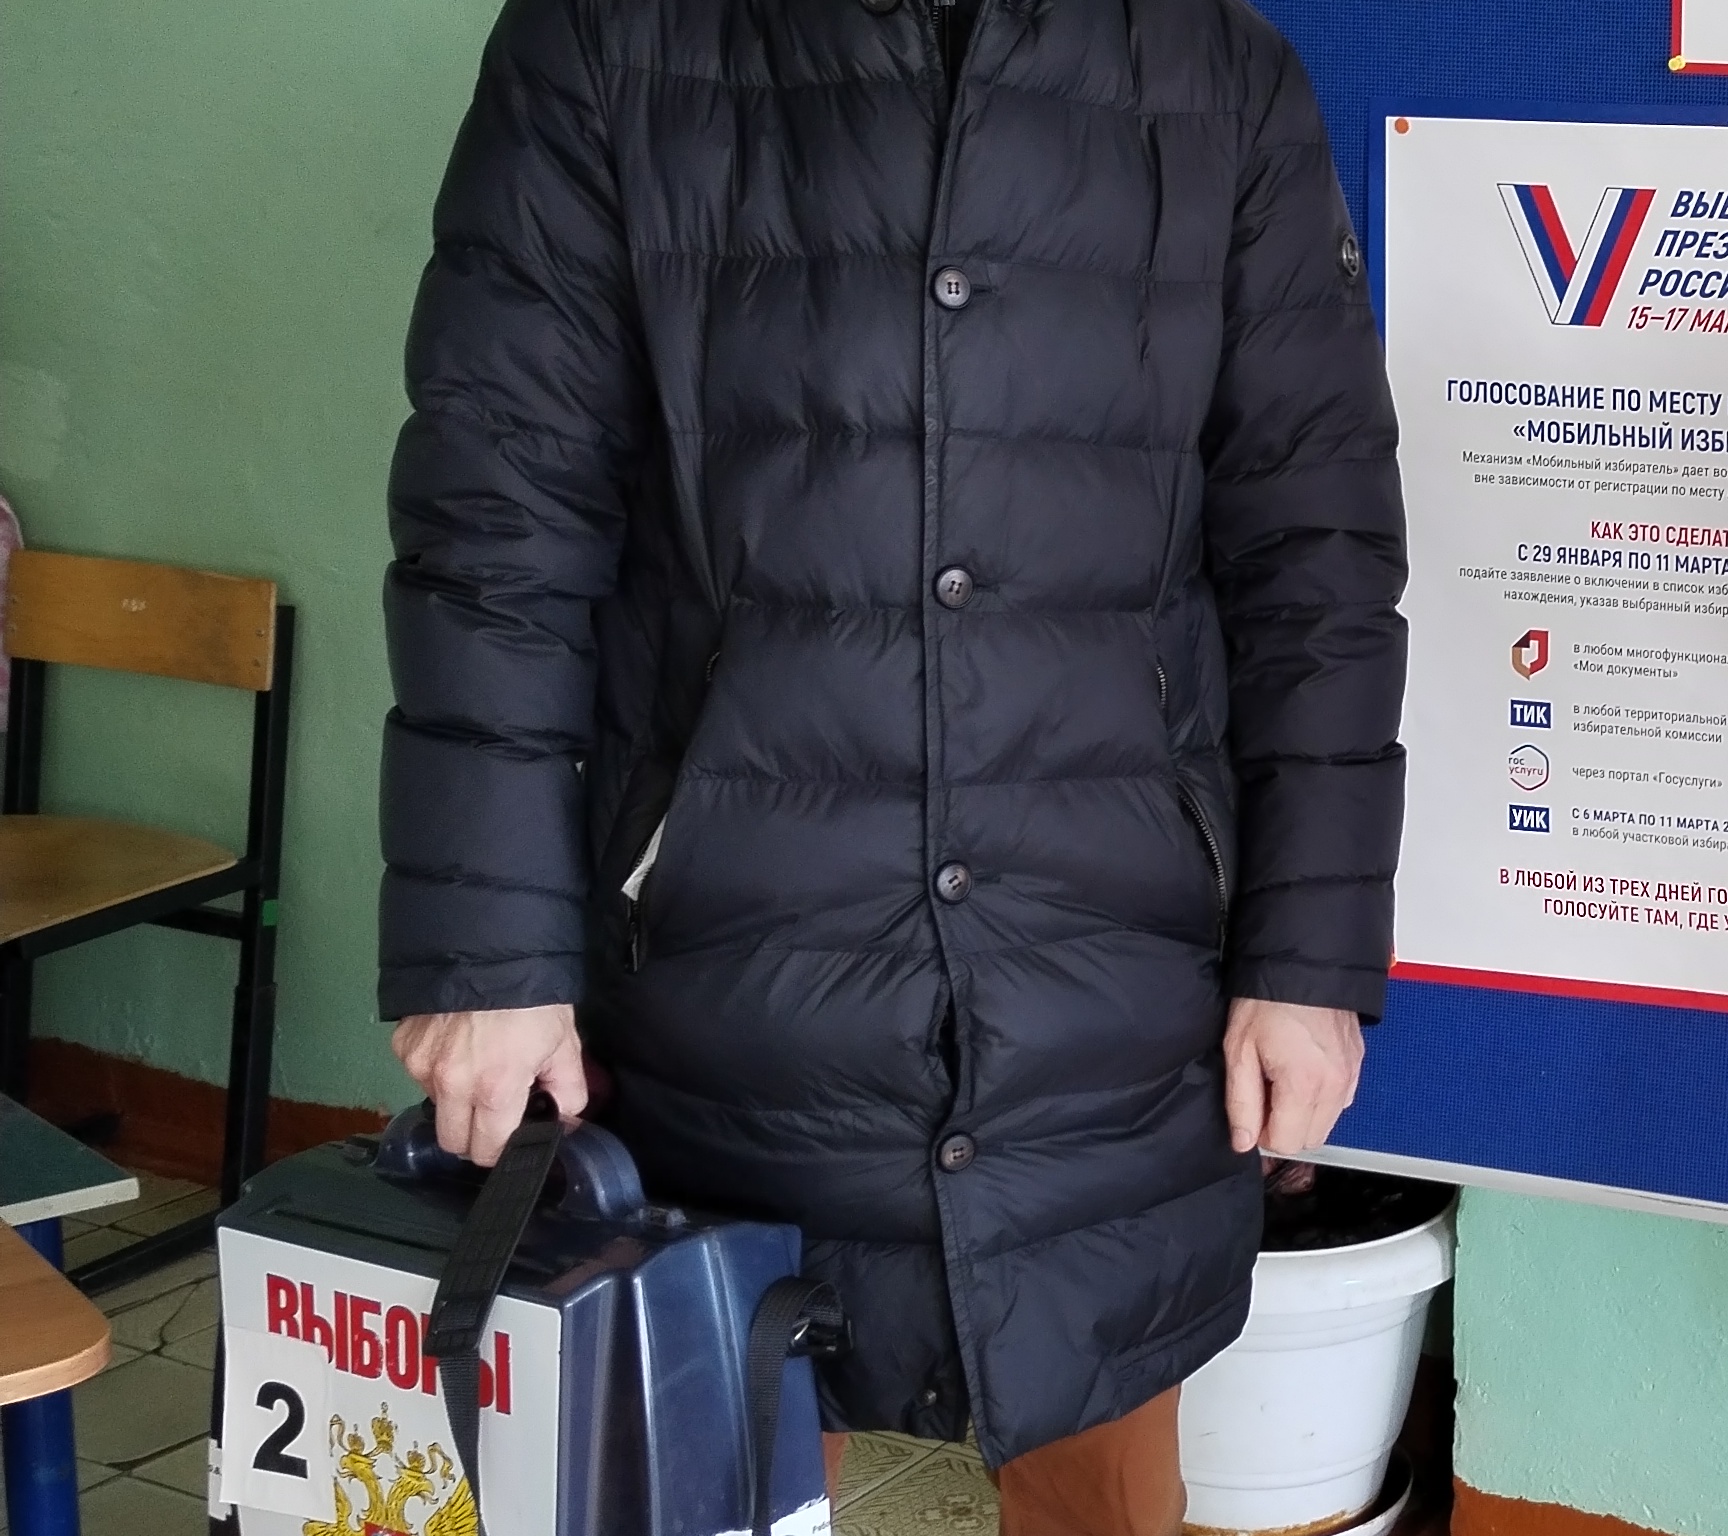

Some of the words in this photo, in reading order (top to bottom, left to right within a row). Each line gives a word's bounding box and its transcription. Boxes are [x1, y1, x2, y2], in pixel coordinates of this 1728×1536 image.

[1447, 380, 1605, 409] ГОЛОСОВАНИЕ
[1612, 388, 1641, 412] ПО
[1649, 390, 1722, 416] МЕСТУ
[1462, 451, 1523, 465] Механизм
[1681, 466, 1710, 478] дает
[1474, 474, 1495, 484] вне
[1498, 475, 1575, 489] зависимости
[1577, 479, 1591, 490] от
[1594, 481, 1668, 496] регистрации
[1671, 485, 1686, 496] по
[1689, 487, 1725, 501] месту
[1591, 521, 1624, 540] КАК
[1628, 523, 1660, 543] ЭТО
[1518, 543, 1528, 561] С
[1532, 544, 1552, 563] 29
[1556, 547, 1622, 568] ЯНВАРЯ
[1628, 551, 1651, 570] ПО
[1656, 553, 1669, 572] 11
[1459, 567, 1507, 580] подайте
[1510, 571, 1571, 585] заявление
[1584, 576, 1649, 590] включении
[1663, 582, 1705, 594] список
[1504, 590, 1577, 606] нахождения,
[1579, 596, 1619, 608] указав
[1622, 598, 1691, 613] выбранный
[1583, 643, 1623, 657] любом
[1513, 704, 1548, 725] ТИК
[1583, 704, 1621, 717] любой
[1624, 709, 1727, 726] территориальной
[1573, 721, 1662, 738] избирательной
[1665, 730, 1722, 743] комиссии
[1572, 767, 1605, 780] через
[1608, 770, 1649, 783] портал
[1512, 808, 1547, 829] УИК
[1593, 809, 1636, 824] МАРТА
[1638, 813, 1656, 826] ПО
[1660, 816, 1672, 828] 11
[1676, 817, 1720, 831] МАРТА
[1581, 827, 1619, 840] любой
[1622, 832, 1689, 846] участковой
[1500, 868, 1510, 885] В
[1514, 870, 1577, 891] ЛЮБОЙ
[1583, 875, 1605, 894] ИЗ
[1609, 878, 1650, 898] ТРЕХ
[1654, 883, 1702, 902] ДНЕЙ
[1544, 898, 1639, 923] ГОЛОСУЙТЕ
[1644, 907, 1683, 929] ТАМ,
[1688, 912, 1719, 931] ГДЕ
[252, 1381, 309, 1480] 2
